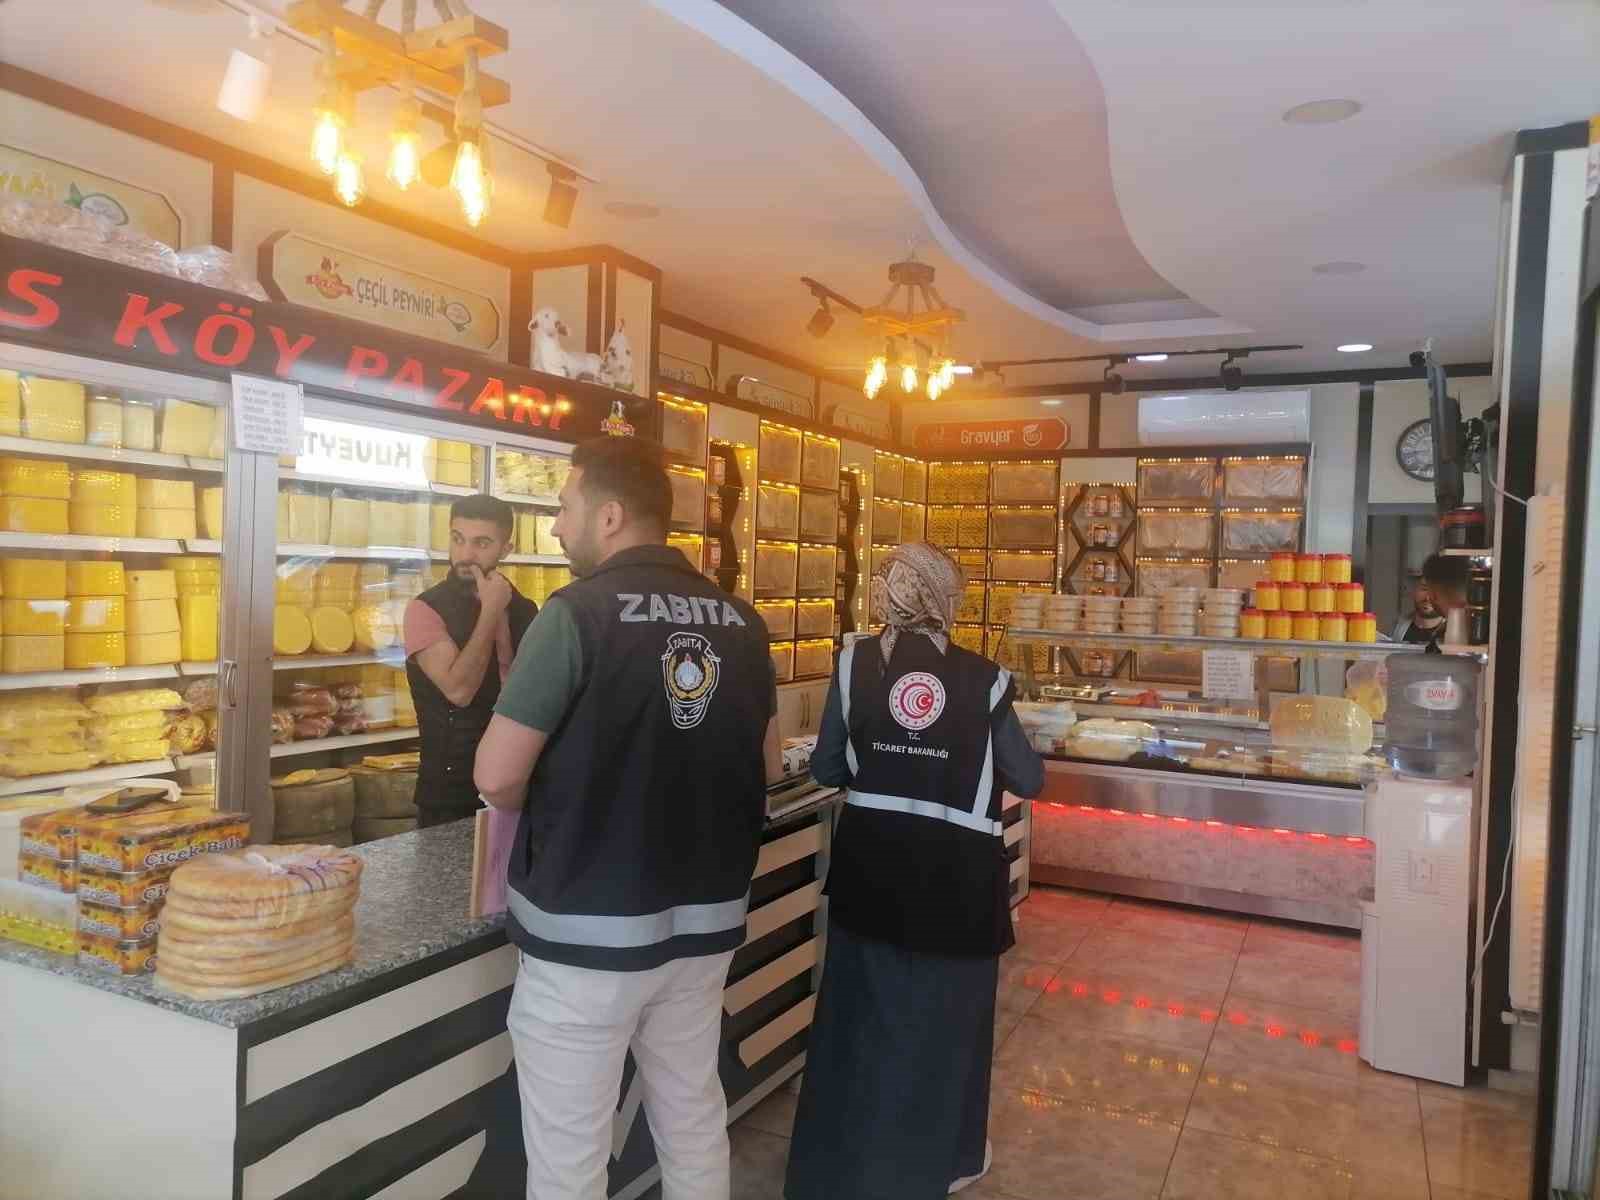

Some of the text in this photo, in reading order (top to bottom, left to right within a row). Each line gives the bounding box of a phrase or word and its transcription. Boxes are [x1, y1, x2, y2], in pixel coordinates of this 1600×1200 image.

[113, 292, 316, 378] KÖY
[342, 344, 568, 431] PAZARI
[960, 429, 1014, 447] Gravyer
[616, 593, 747, 627] ZABITA
[671, 637, 703, 651] ZABITA
[871, 740, 950, 760] TİCARET BAKANLIĞI
